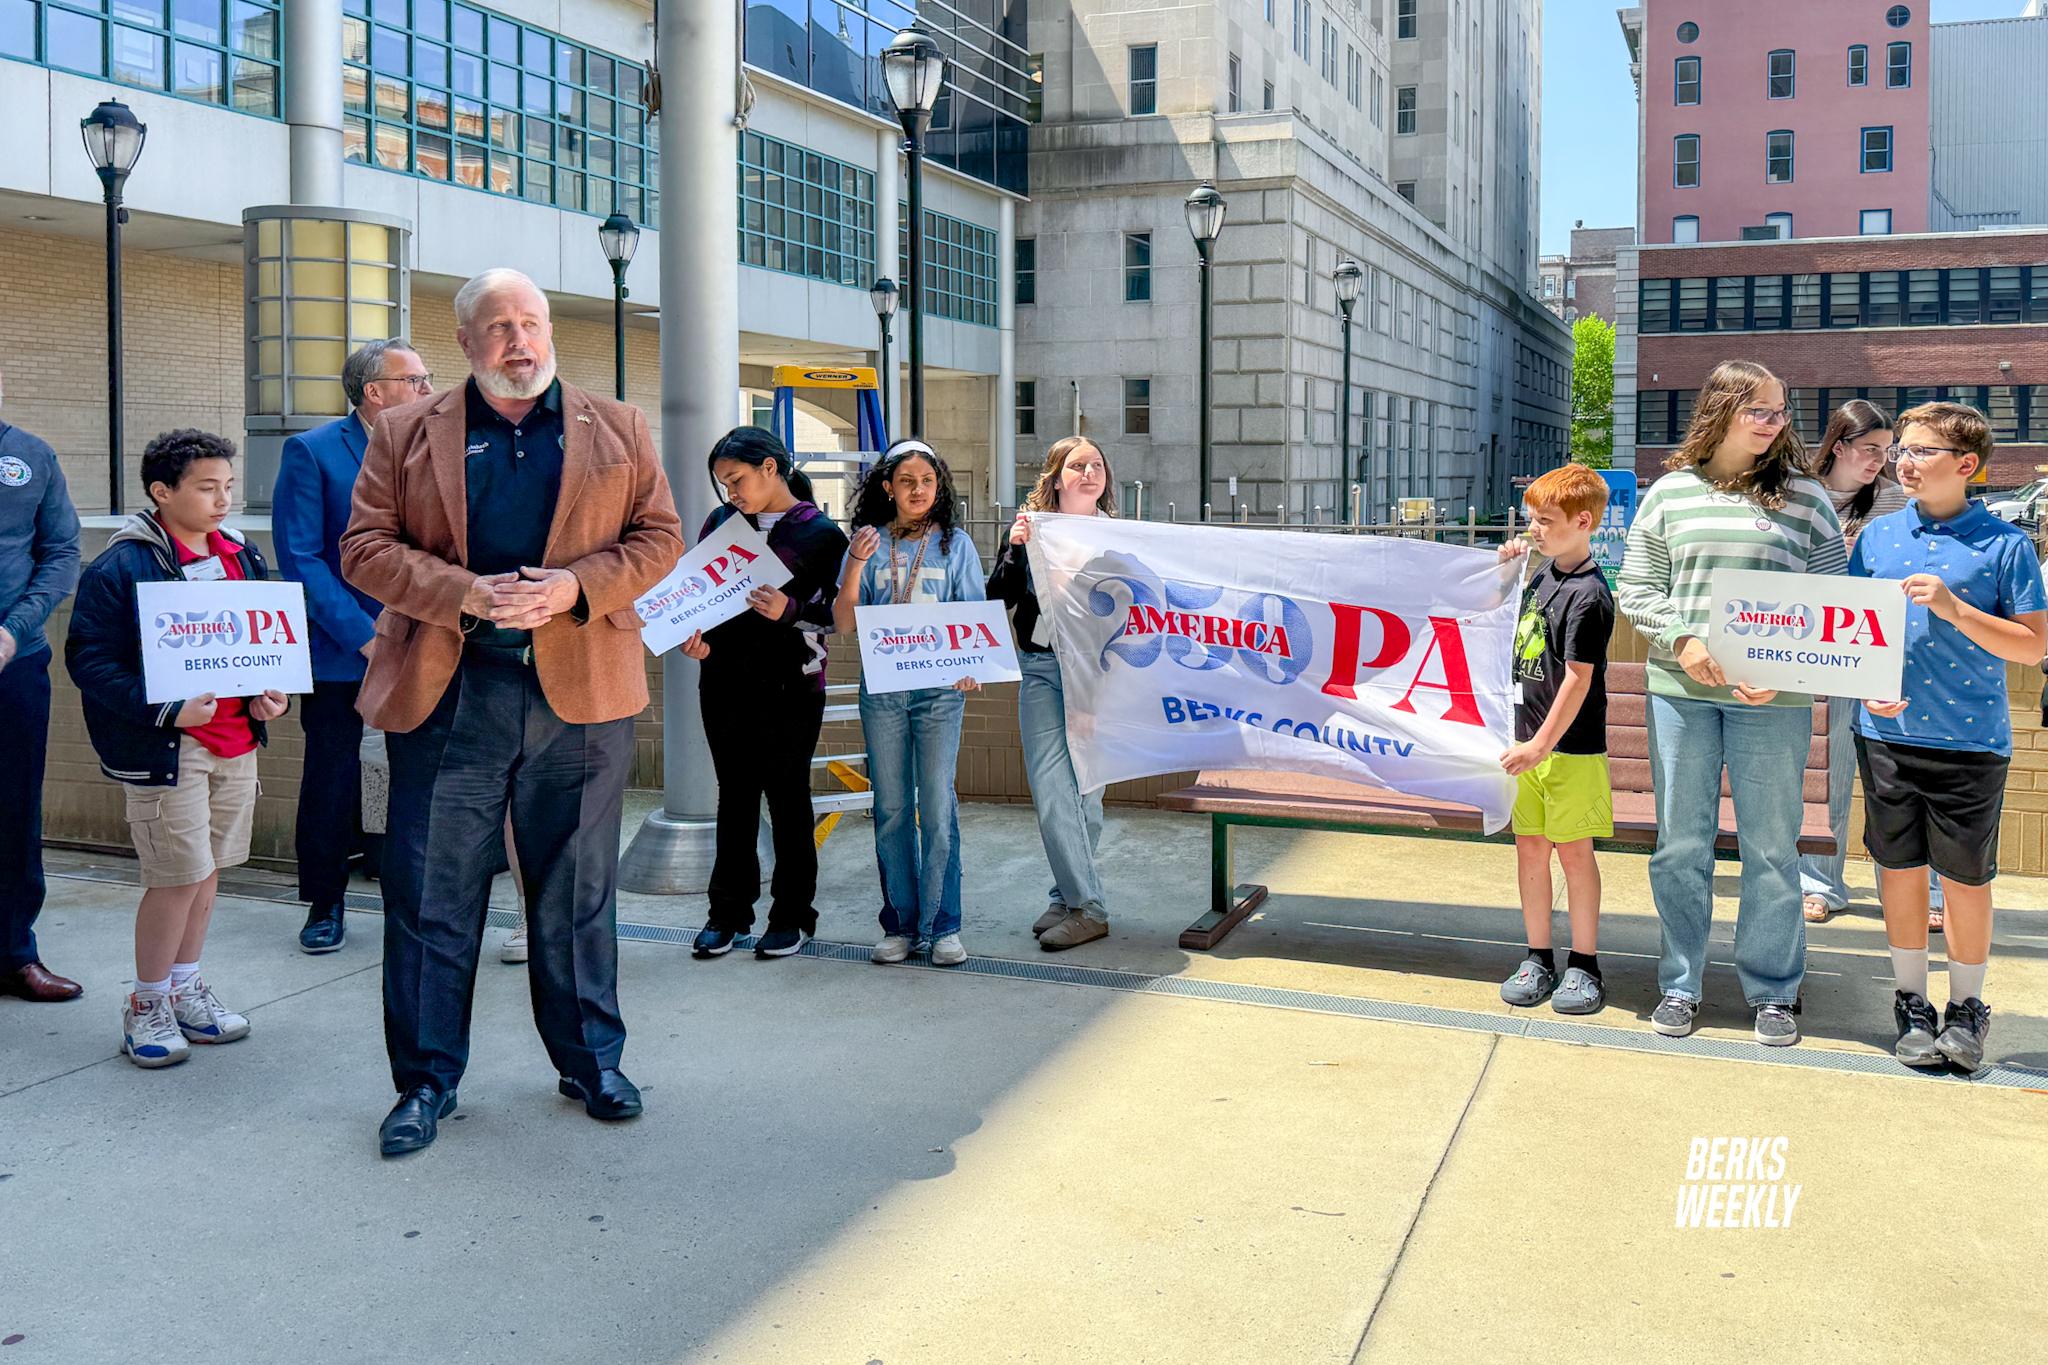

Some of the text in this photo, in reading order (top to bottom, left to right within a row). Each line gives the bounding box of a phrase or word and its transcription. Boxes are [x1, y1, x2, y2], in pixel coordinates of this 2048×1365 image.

[638, 544, 759, 620] 250 PA
[648, 583, 700, 613] AMERICA
[671, 576, 752, 625] BERKS COUNTY
[155, 610, 297, 649] 250 PA
[168, 622, 236, 636] AMERICA
[1123, 605, 1293, 659] AMERICA
[1724, 599, 1888, 647] 250 PA
[1736, 611, 1806, 627] AMERICA
[869, 623, 1000, 655] 250 PA
[881, 634, 936, 645] AMERICA
[1088, 576, 1313, 685] 250
[1321, 602, 1486, 727] PA
[184, 655, 282, 671] BERKS COUNTY
[896, 656, 984, 671] BERKS COUNTY
[1747, 647, 1861, 668] BERKS COUNTY
